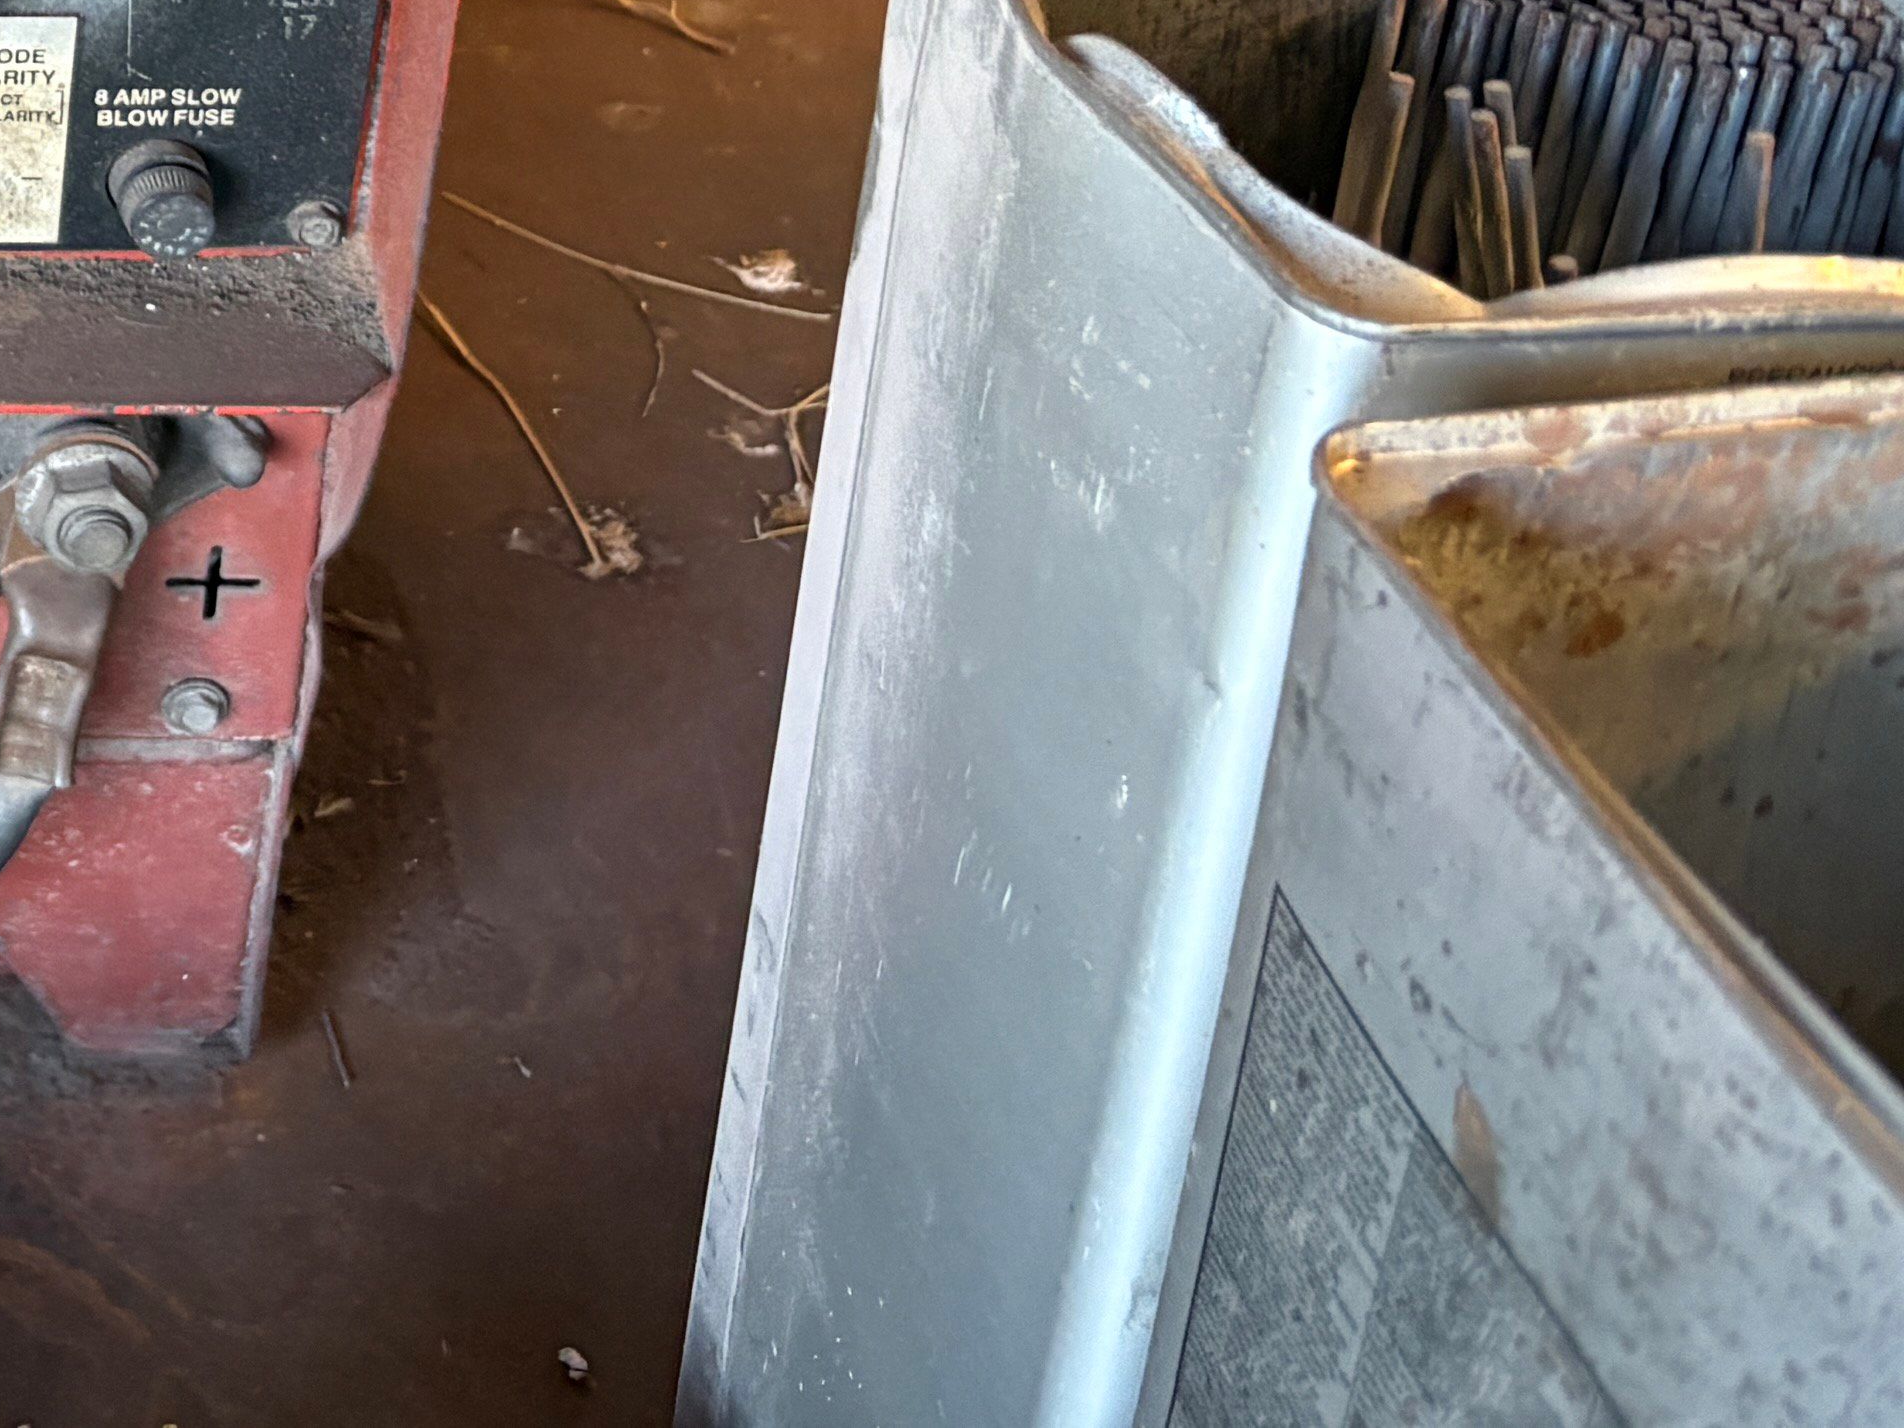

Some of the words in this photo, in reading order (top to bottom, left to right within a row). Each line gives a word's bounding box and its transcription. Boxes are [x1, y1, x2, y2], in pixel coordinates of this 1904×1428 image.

[95, 89, 108, 105] 8
[114, 89, 166, 105] AMP
[171, 88, 241, 105] SLOW
[97, 110, 171, 126] BLOW
[174, 109, 235, 125] FUSE
